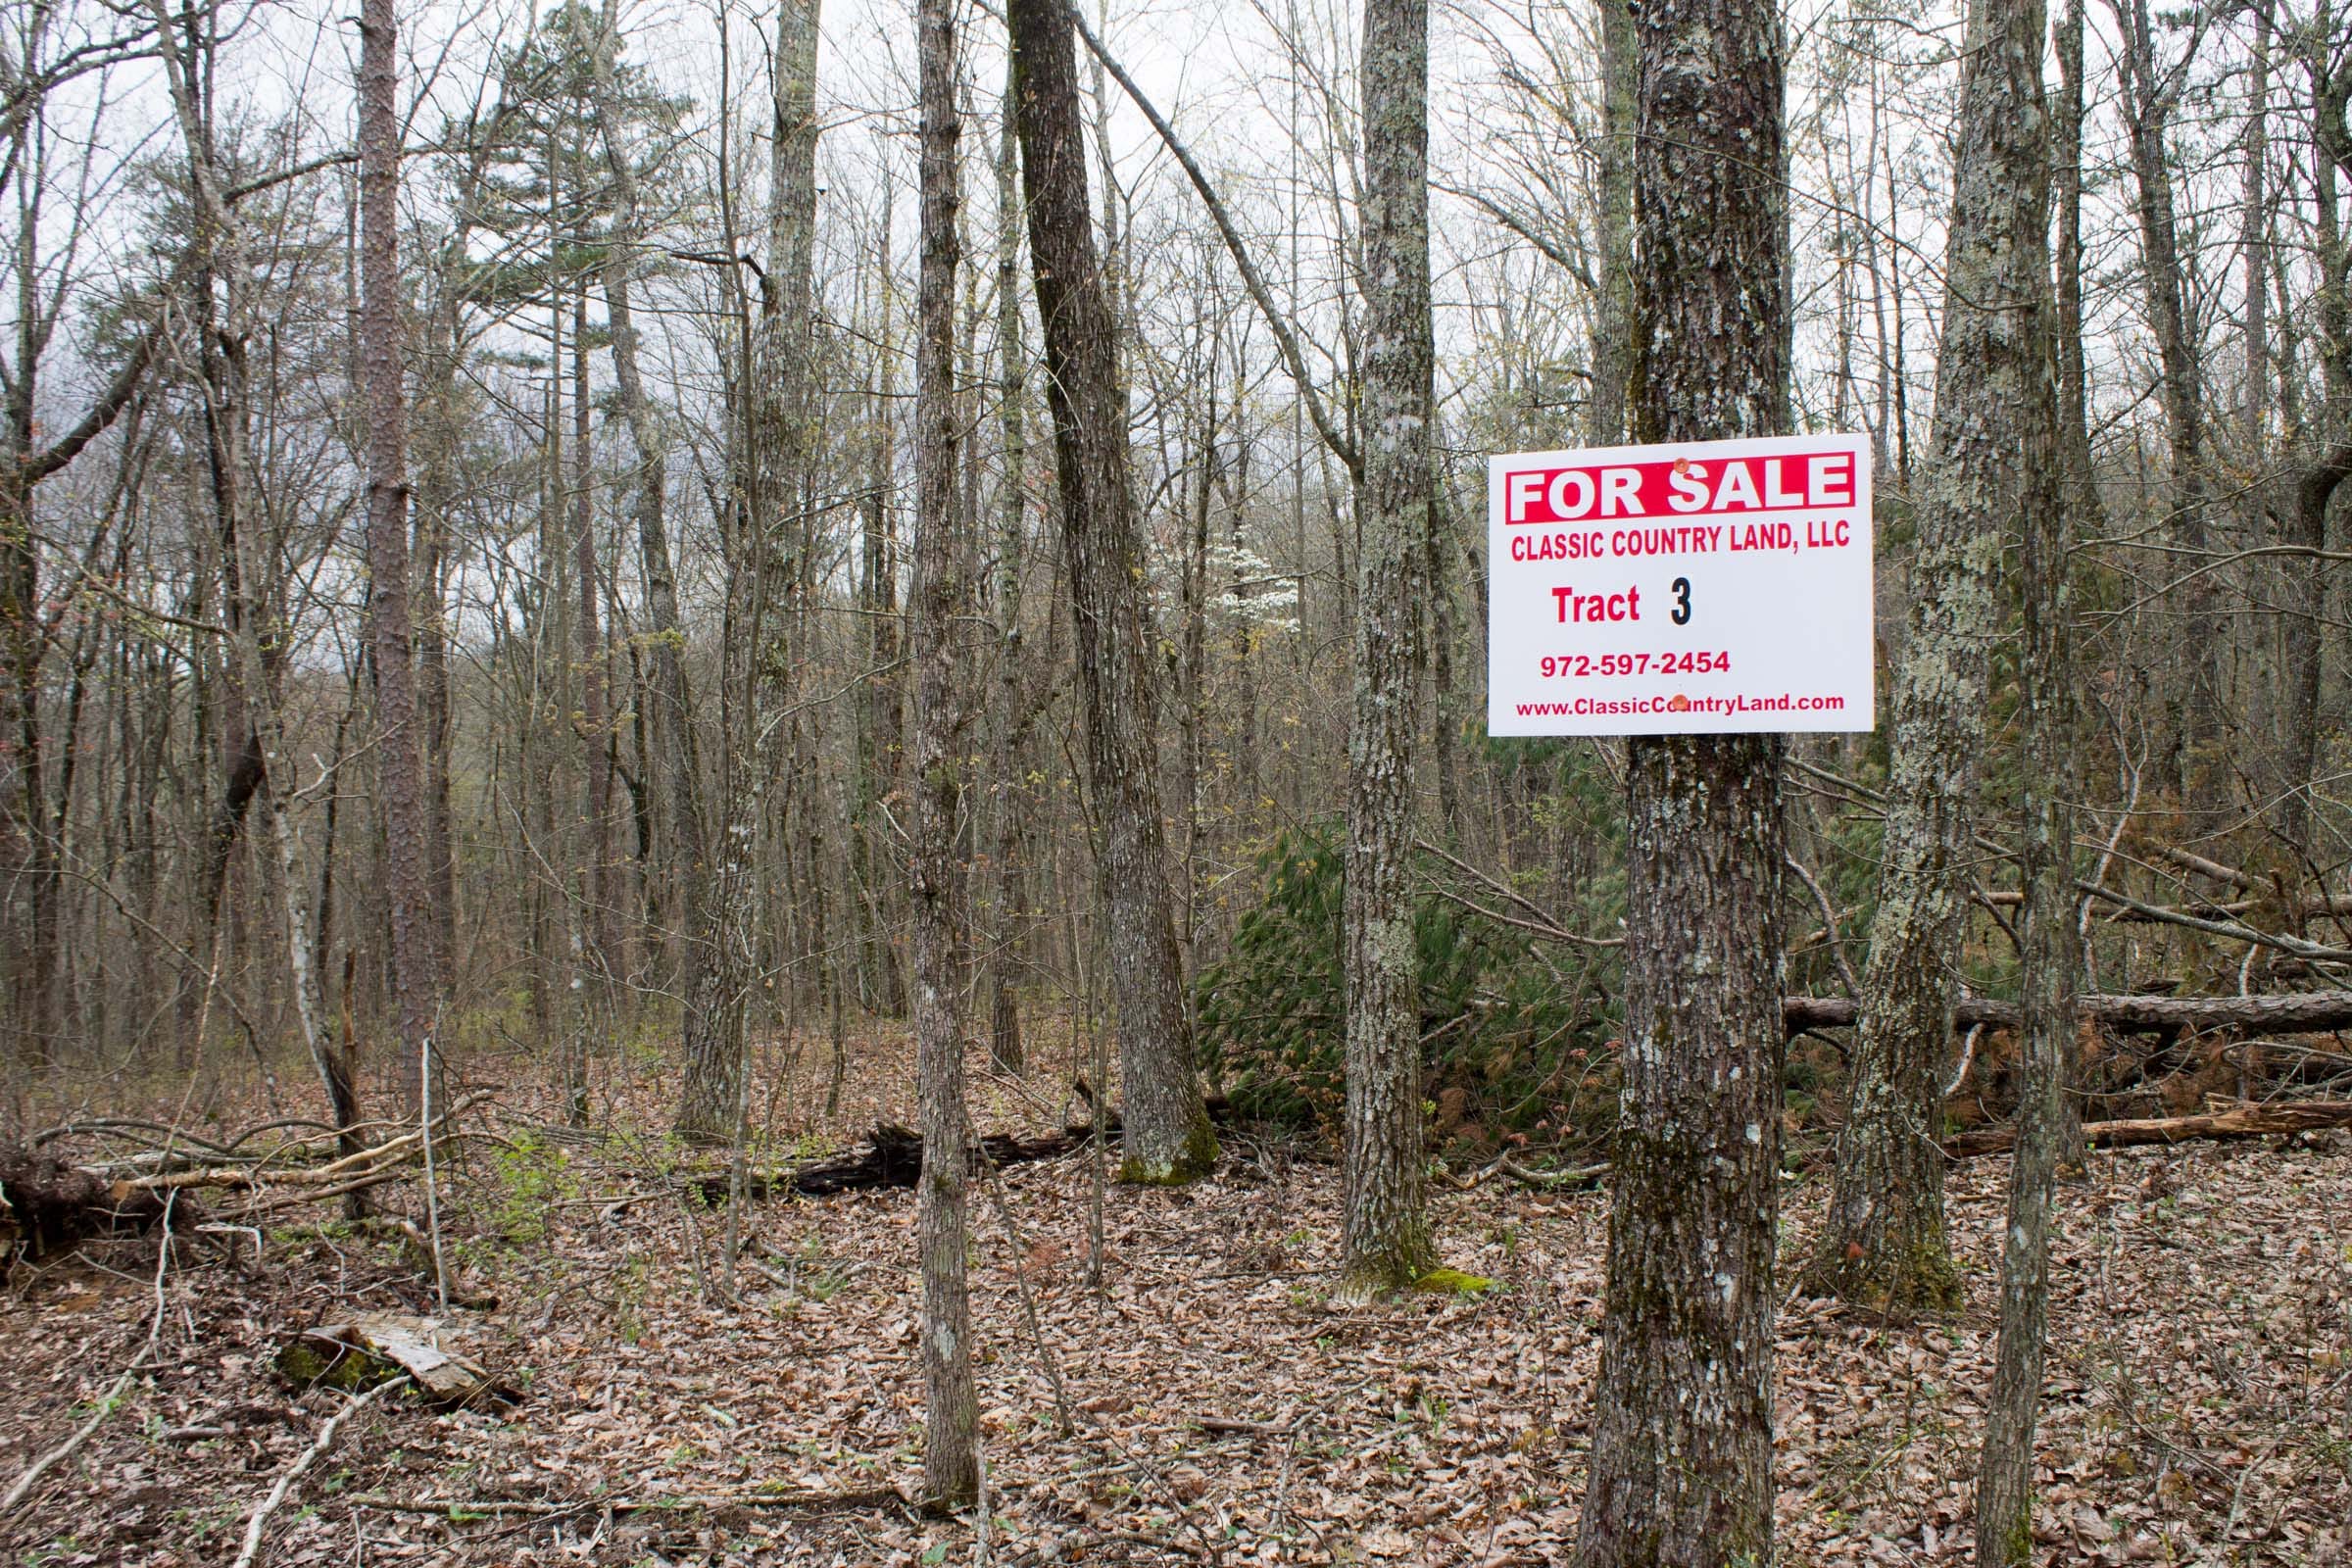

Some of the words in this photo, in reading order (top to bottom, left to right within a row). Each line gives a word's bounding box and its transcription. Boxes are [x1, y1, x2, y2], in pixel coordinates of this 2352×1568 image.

[1509, 466, 1645, 521] FOR
[1667, 456, 1850, 513] SALE
[1511, 531, 1604, 563] CLASSIC
[1611, 525, 1723, 558] COUNTRY
[1730, 522, 1799, 555] LAND,
[1807, 519, 1850, 549] LLC
[1551, 584, 1641, 623] Tract
[1670, 576, 1692, 626] 3
[1540, 650, 1731, 678] 972-597-2454
